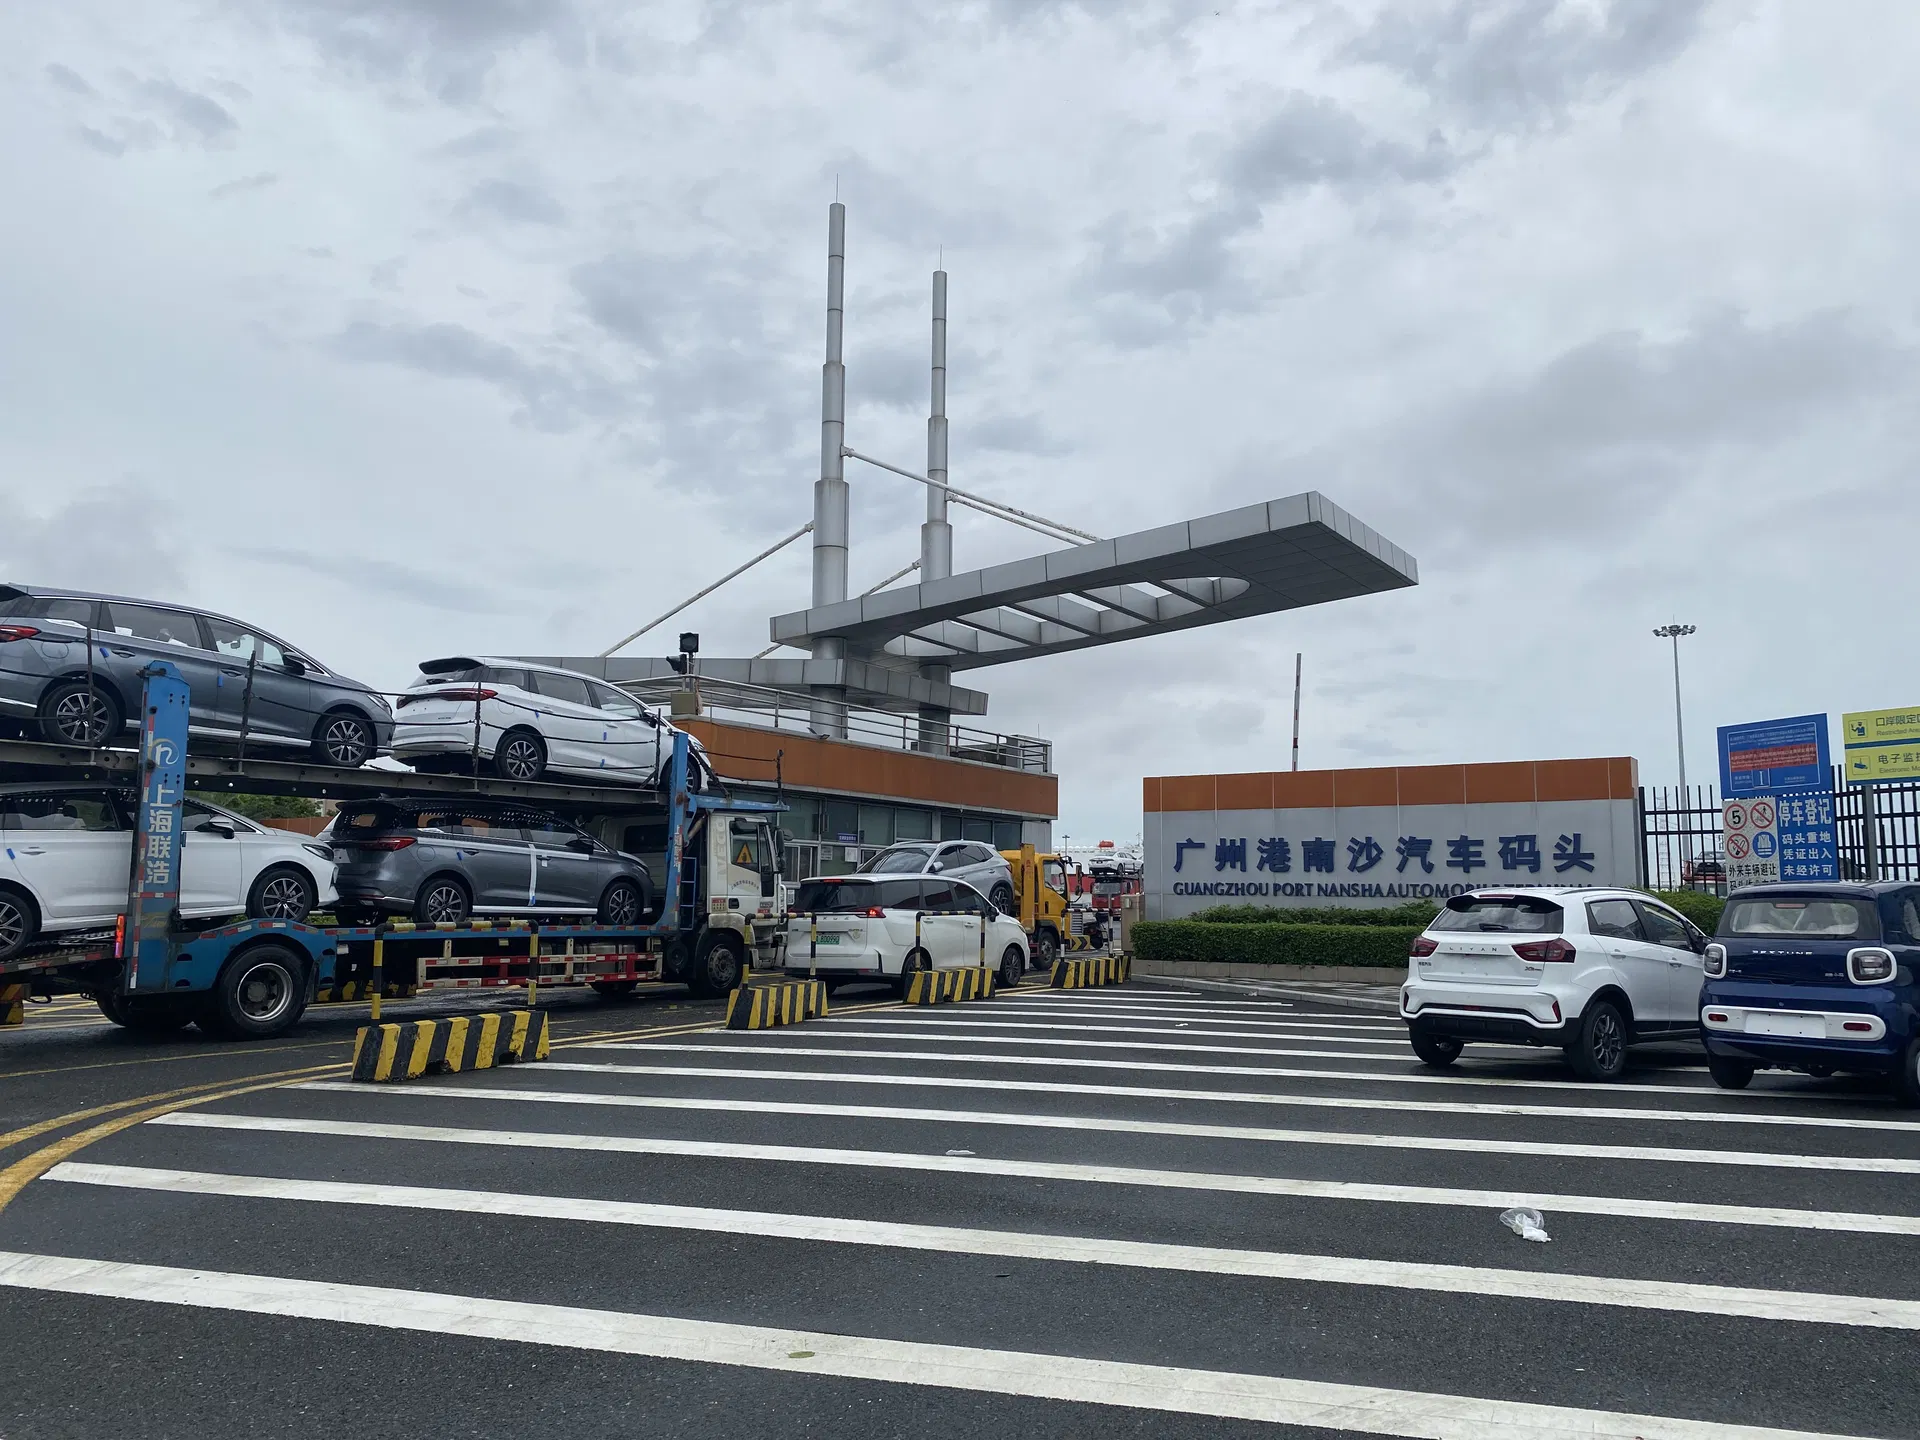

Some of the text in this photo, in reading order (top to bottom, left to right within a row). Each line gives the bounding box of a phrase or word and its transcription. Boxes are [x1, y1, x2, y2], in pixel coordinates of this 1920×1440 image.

[1732, 810, 1741, 825] 5
[1779, 798, 1832, 828] 停车登记
[145, 783, 175, 884] 上海联浩
[1782, 831, 1832, 845] 码头重地
[1173, 834, 1596, 873] 广州港南沙汽车码头
[1783, 848, 1833, 860] 凭证出入
[1729, 862, 1777, 877] 外来车辆避让
[1784, 864, 1833, 877] 未经许可
[1172, 882, 1269, 896] GUANGZHOU
[1273, 882, 1314, 897] PORT
[1317, 882, 1385, 897] NANSHA
